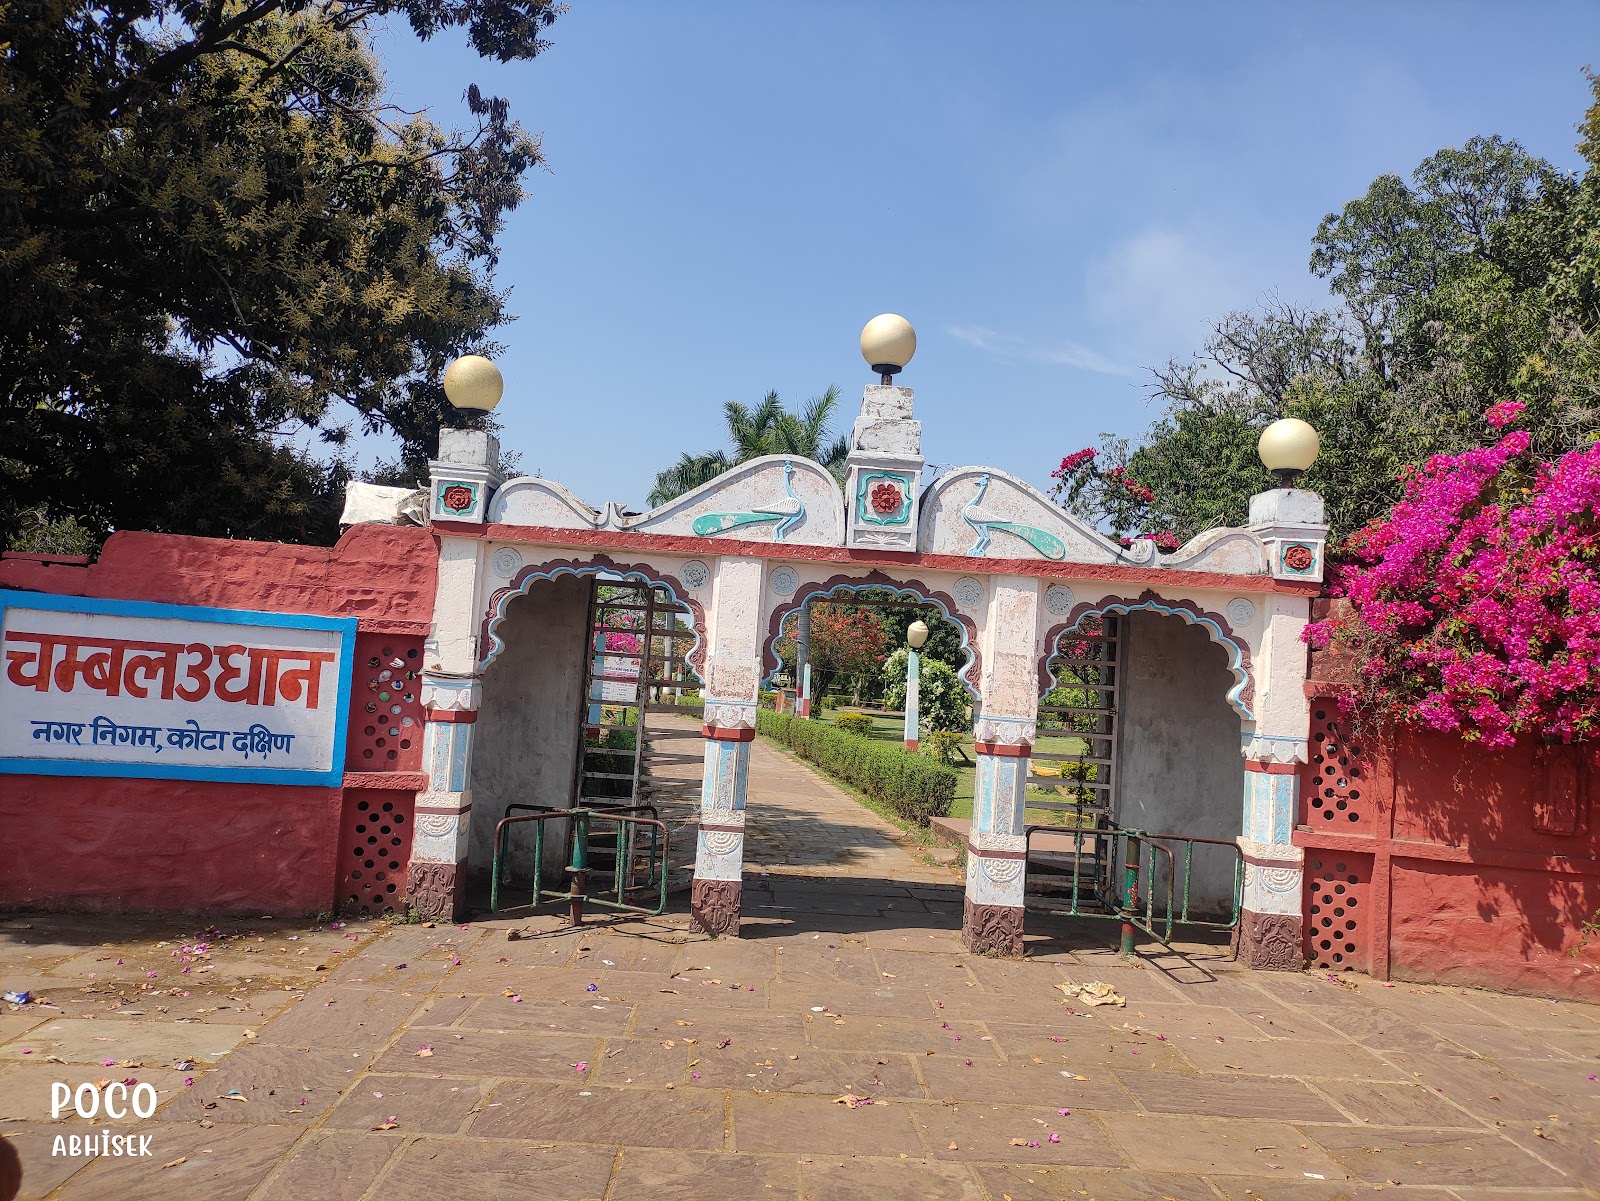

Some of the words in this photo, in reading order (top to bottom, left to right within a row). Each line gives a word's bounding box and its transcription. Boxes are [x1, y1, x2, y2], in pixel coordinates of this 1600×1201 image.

[30, 720, 86, 746] नगर
[166, 719, 231, 752] कोटा
[232, 723, 296, 760] दक्षिण
